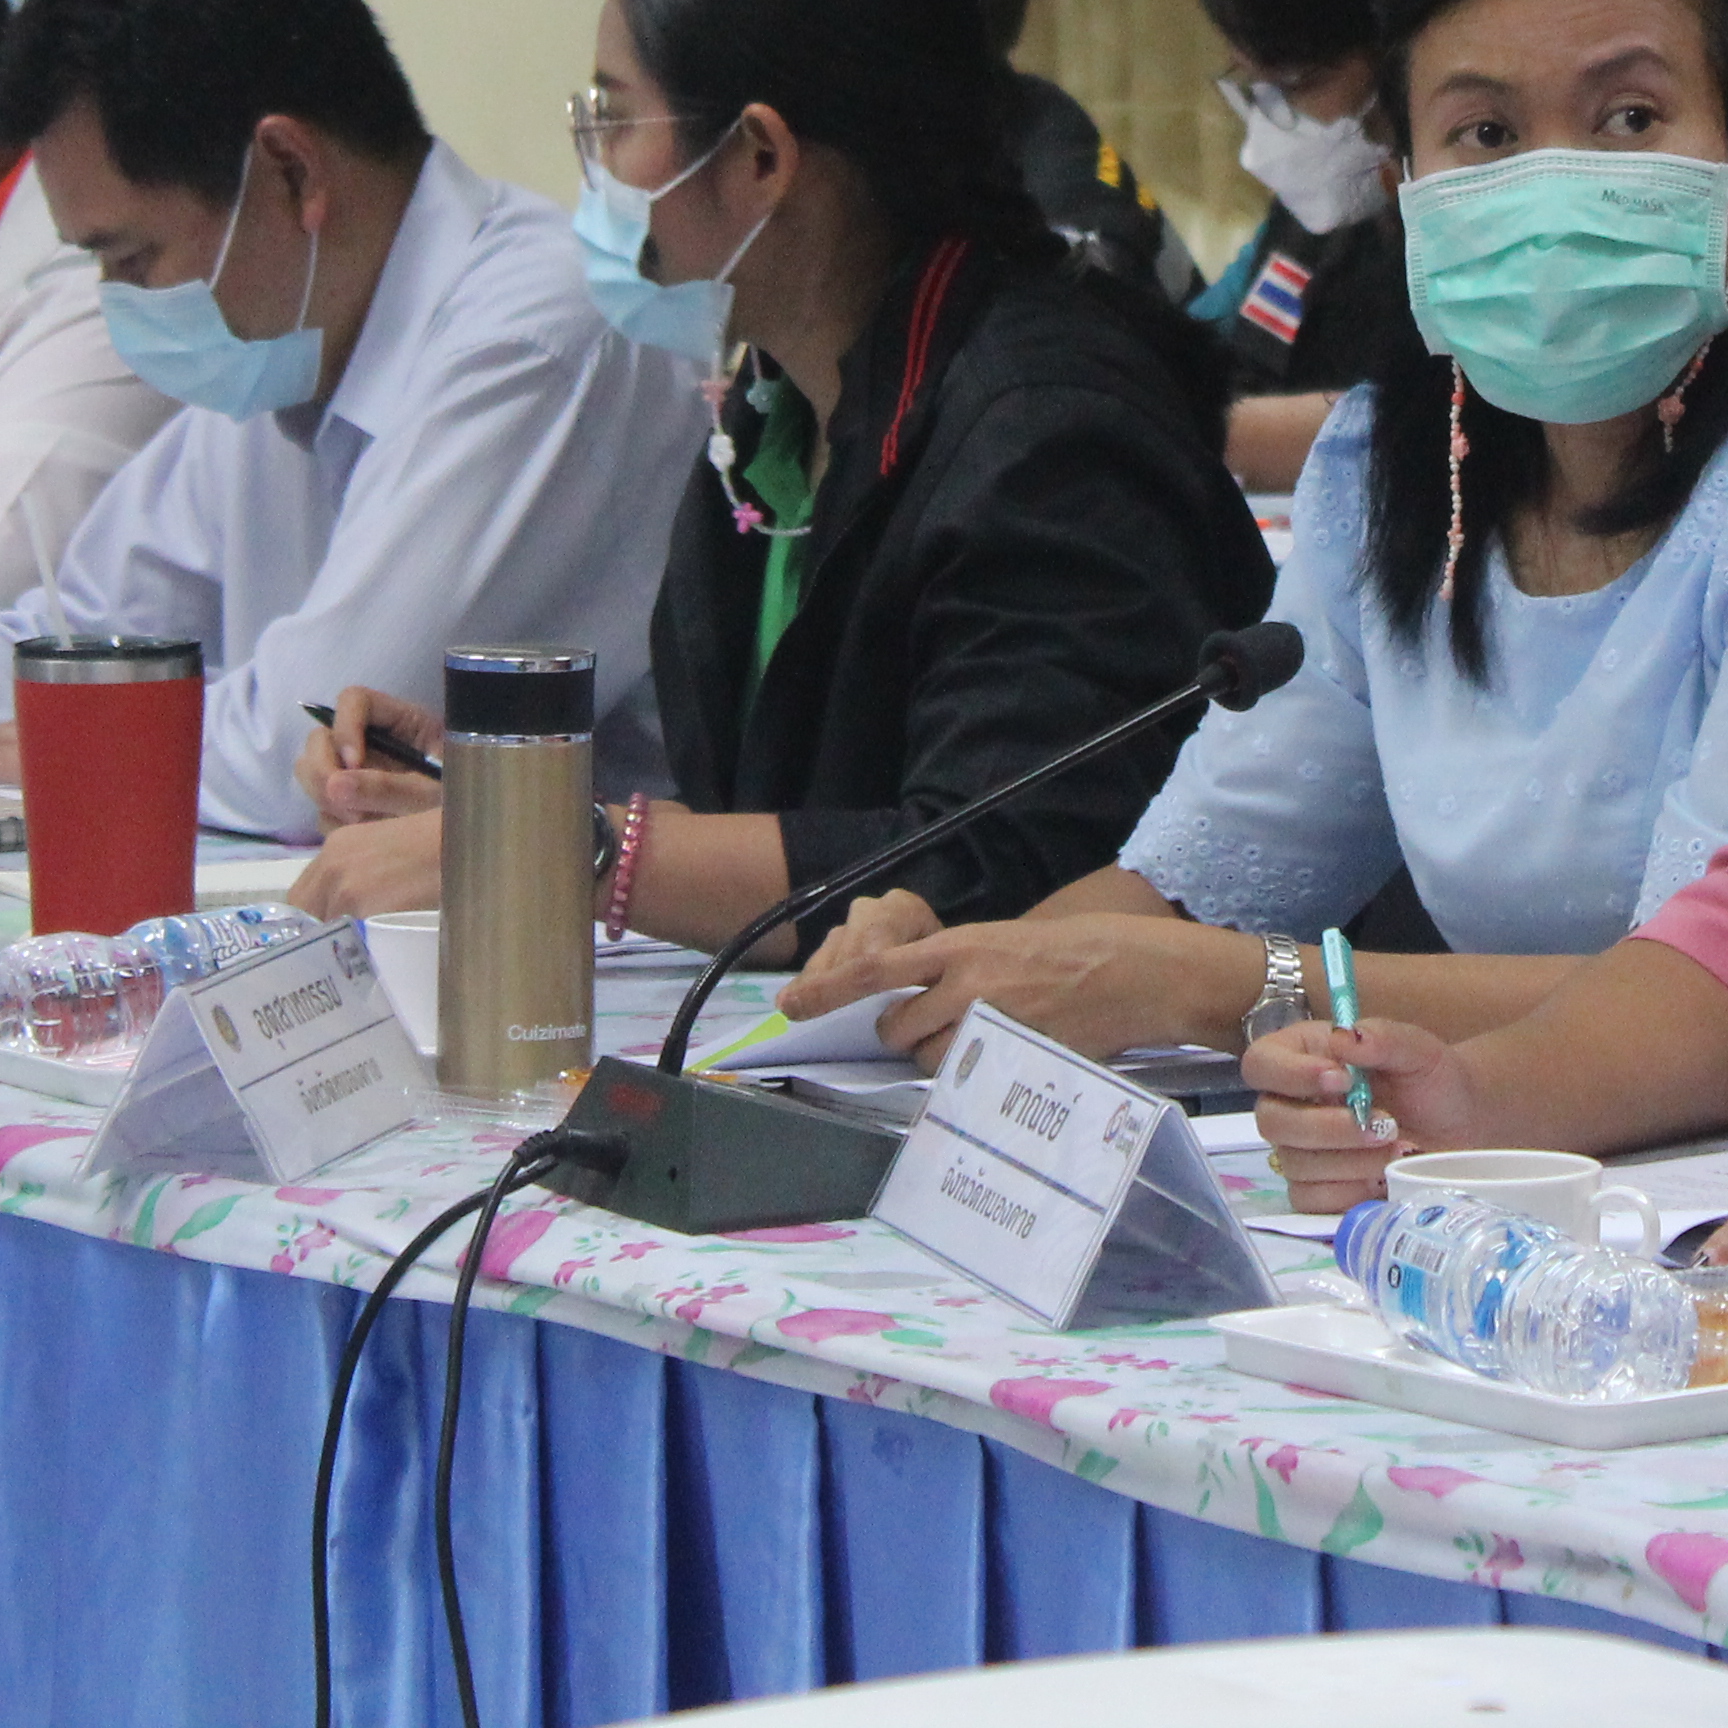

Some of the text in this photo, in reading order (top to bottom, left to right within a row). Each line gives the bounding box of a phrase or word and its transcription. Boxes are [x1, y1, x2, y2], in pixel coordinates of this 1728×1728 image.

[999, 1080, 1084, 1142] พาณิชย์
[940, 1155, 1038, 1239] จังหวัดหนองคาย
